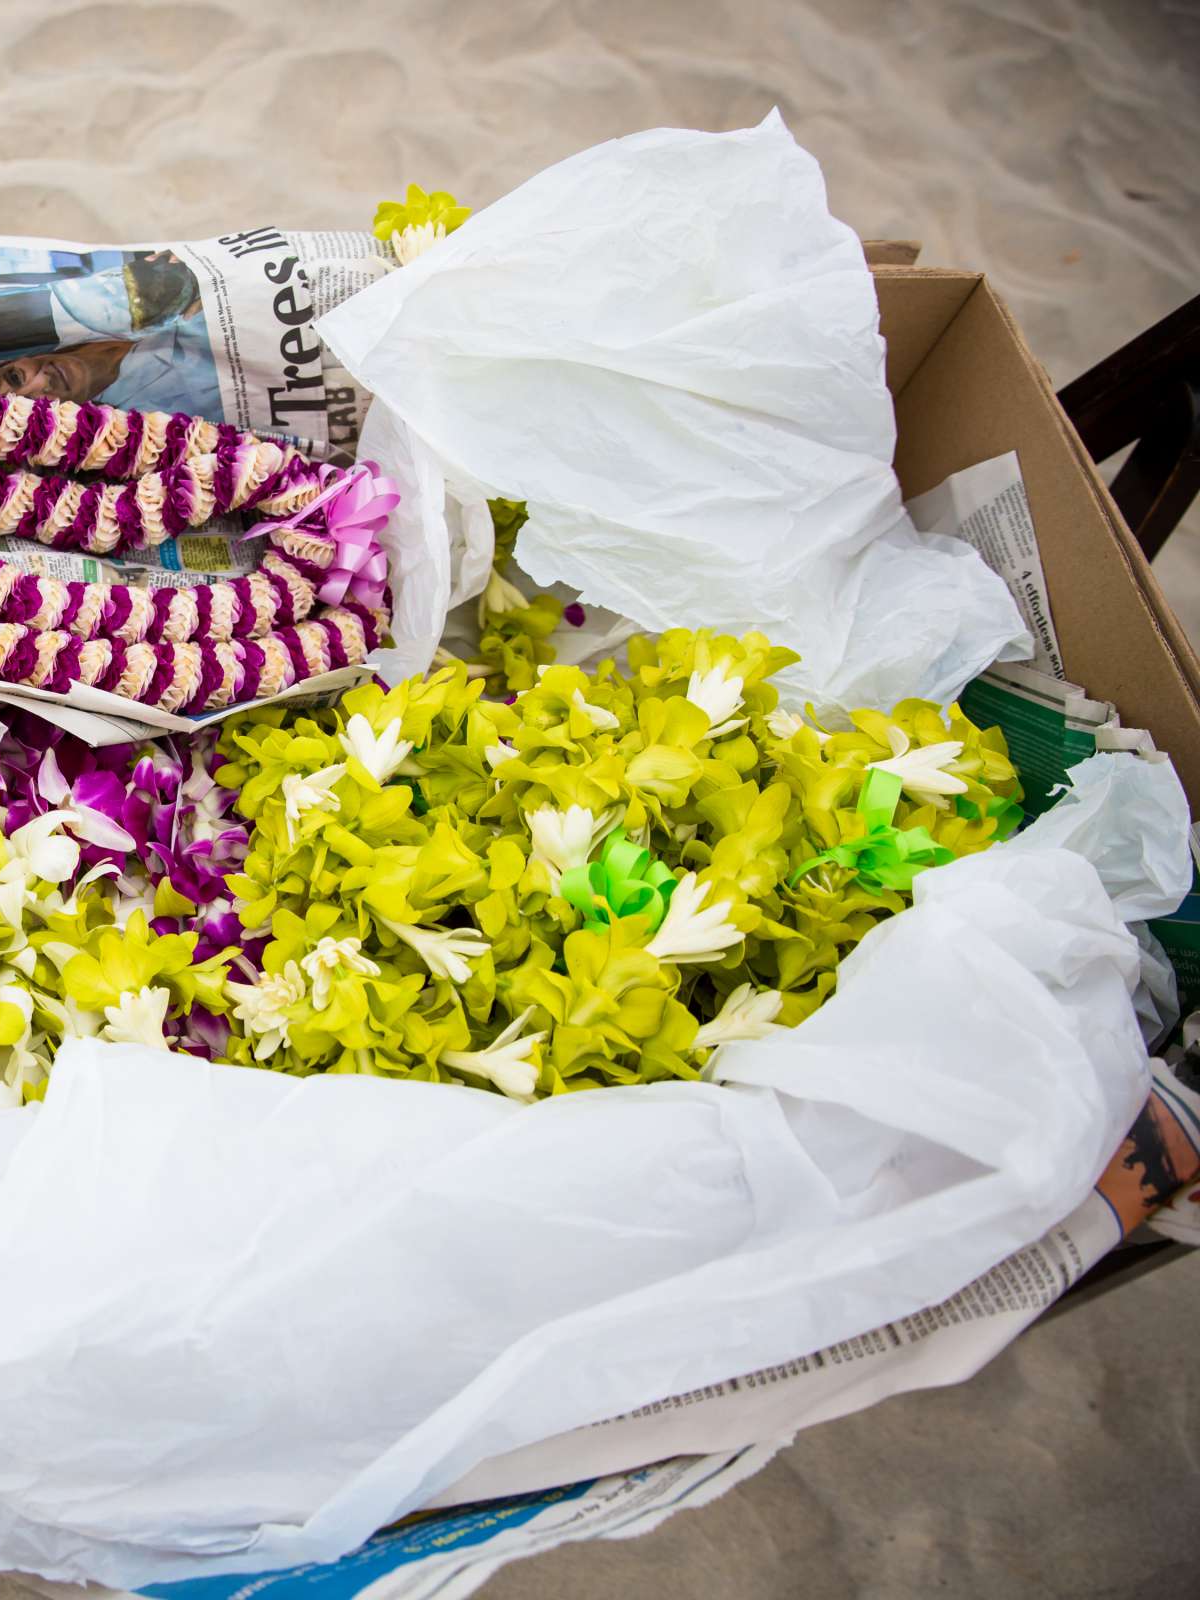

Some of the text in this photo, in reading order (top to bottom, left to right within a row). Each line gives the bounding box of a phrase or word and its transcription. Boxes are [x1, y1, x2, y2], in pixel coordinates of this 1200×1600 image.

[264, 256, 327, 427] Trees
[1021, 568, 1032, 581] 4
[1024, 582, 1053, 652] effortless
